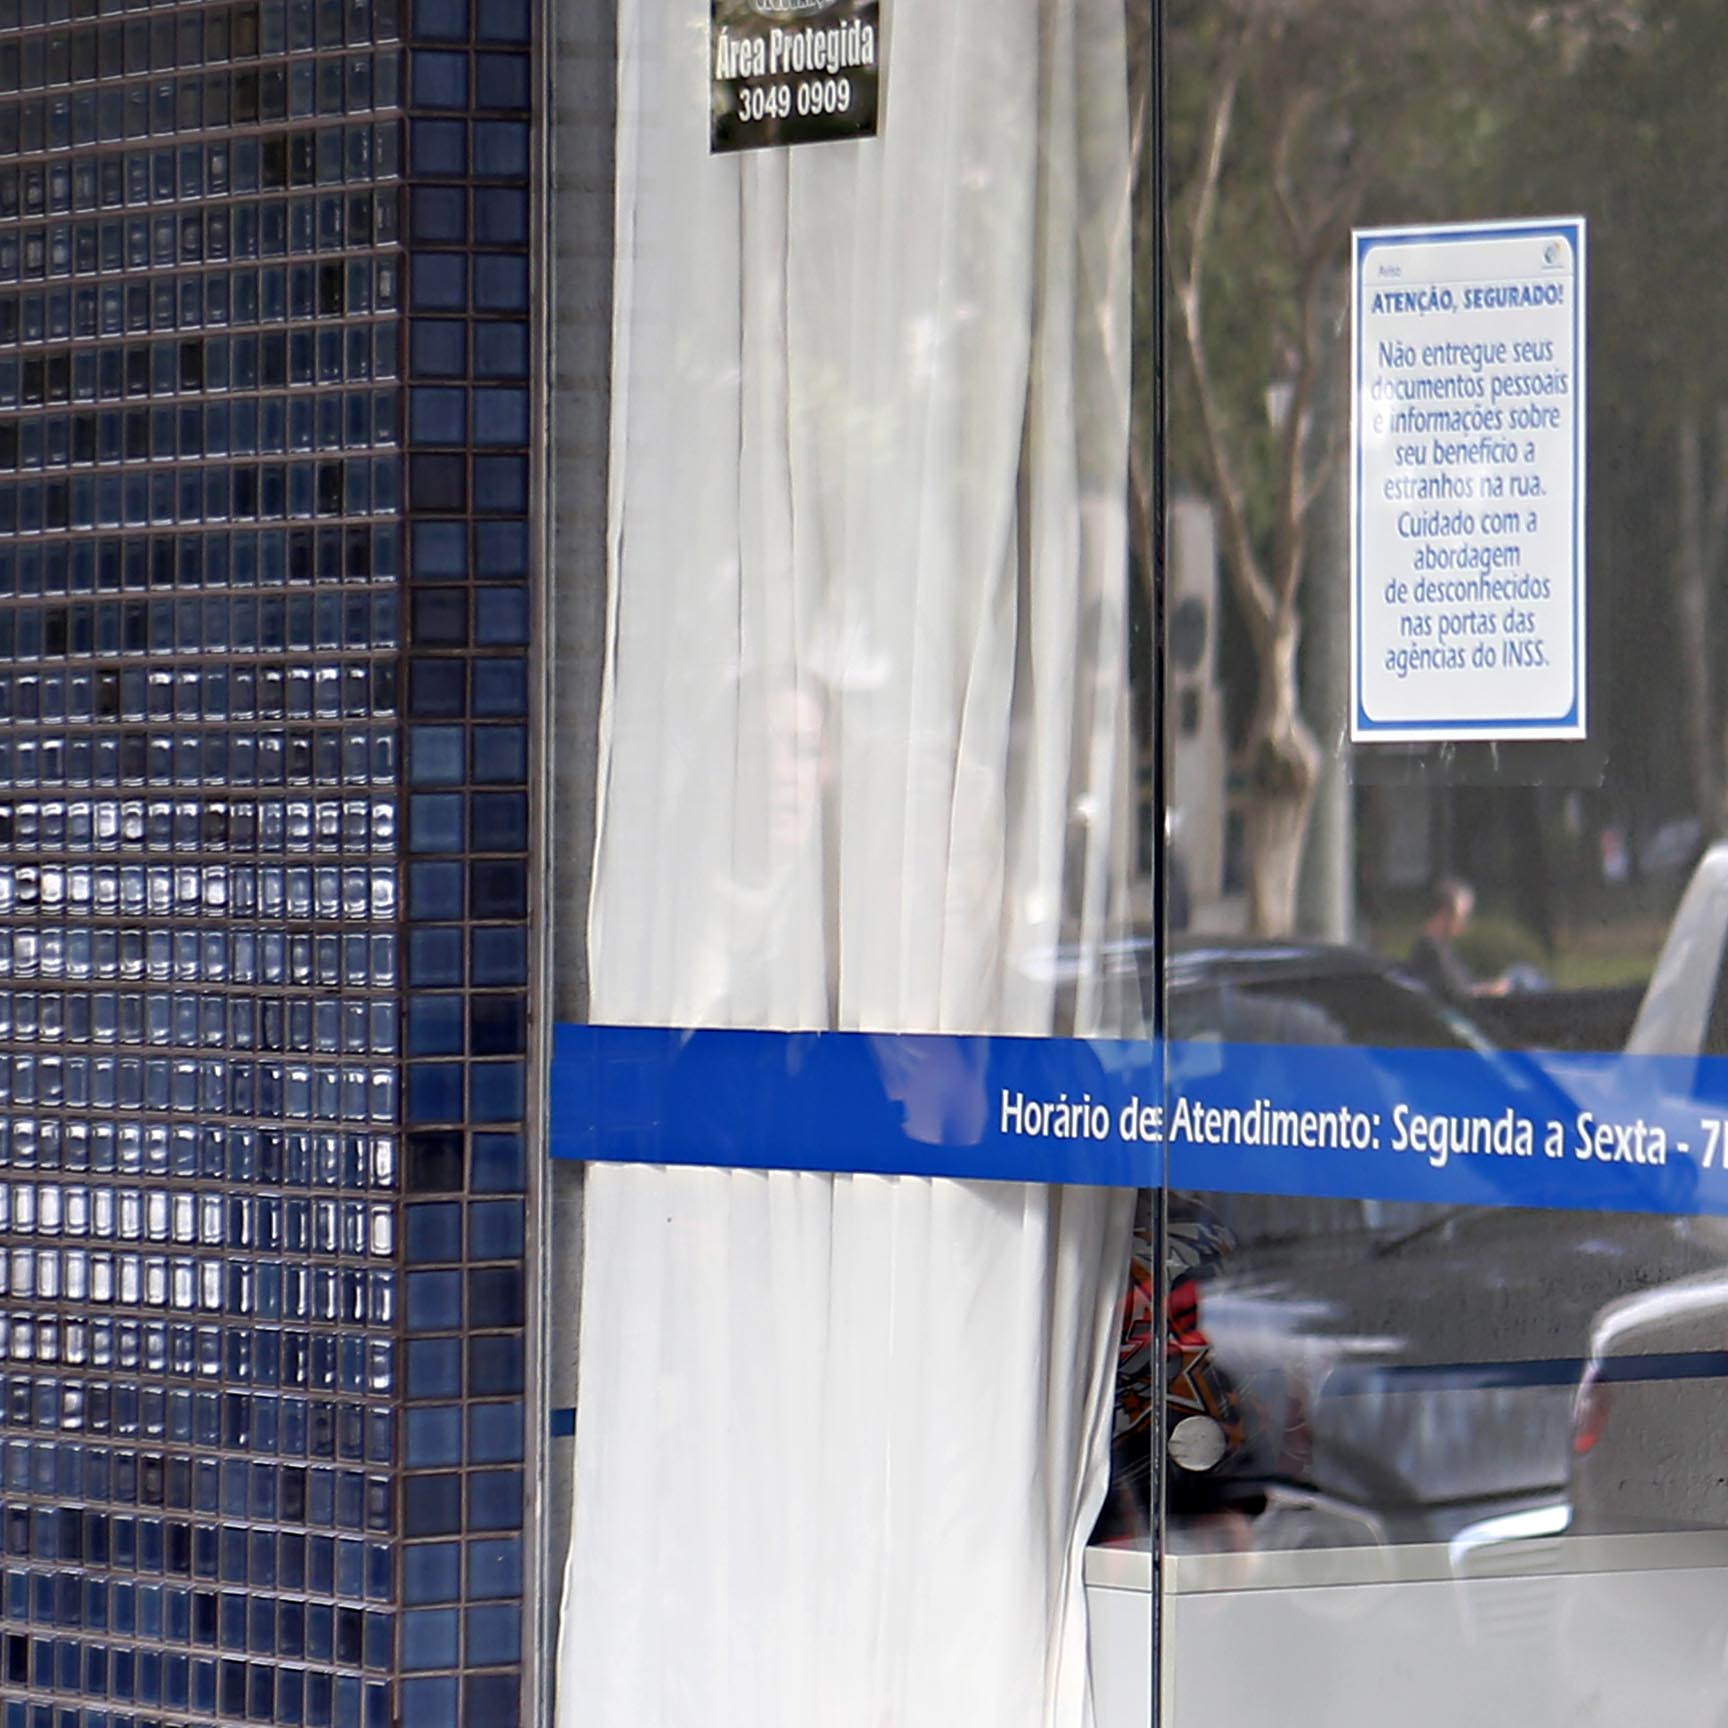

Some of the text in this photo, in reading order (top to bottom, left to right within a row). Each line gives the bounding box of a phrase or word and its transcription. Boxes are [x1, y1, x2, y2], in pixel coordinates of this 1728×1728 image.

[715, 18, 875, 81] Área Protegida
[738, 78, 851, 122] 3049 0909
[1371, 283, 1564, 317] ATENÇÃO, SEGURADO!
[1378, 339, 1553, 373] Não entregue seus
[1371, 368, 1569, 405] documentos pessoais
[1372, 402, 1560, 438] e informações sobre
[1395, 436, 1536, 468] seu benefício a
[1384, 473, 1548, 501] estranhos na rua.
[1397, 510, 1538, 538] Cuidado com a
[1414, 543, 1521, 576] abordagem
[1384, 571, 1551, 604] de desconhecidos
[1400, 607, 1536, 645] nas portas das
[1385, 639, 1550, 679] agências do INSS.
[1001, 1088, 1109, 1142] Horário
[1168, 1096, 1381, 1152] Atendimento:
[1392, 1105, 1534, 1170] Segunda
[1544, 1120, 1564, 1158] a
[1574, 1112, 1667, 1166] Sexta
